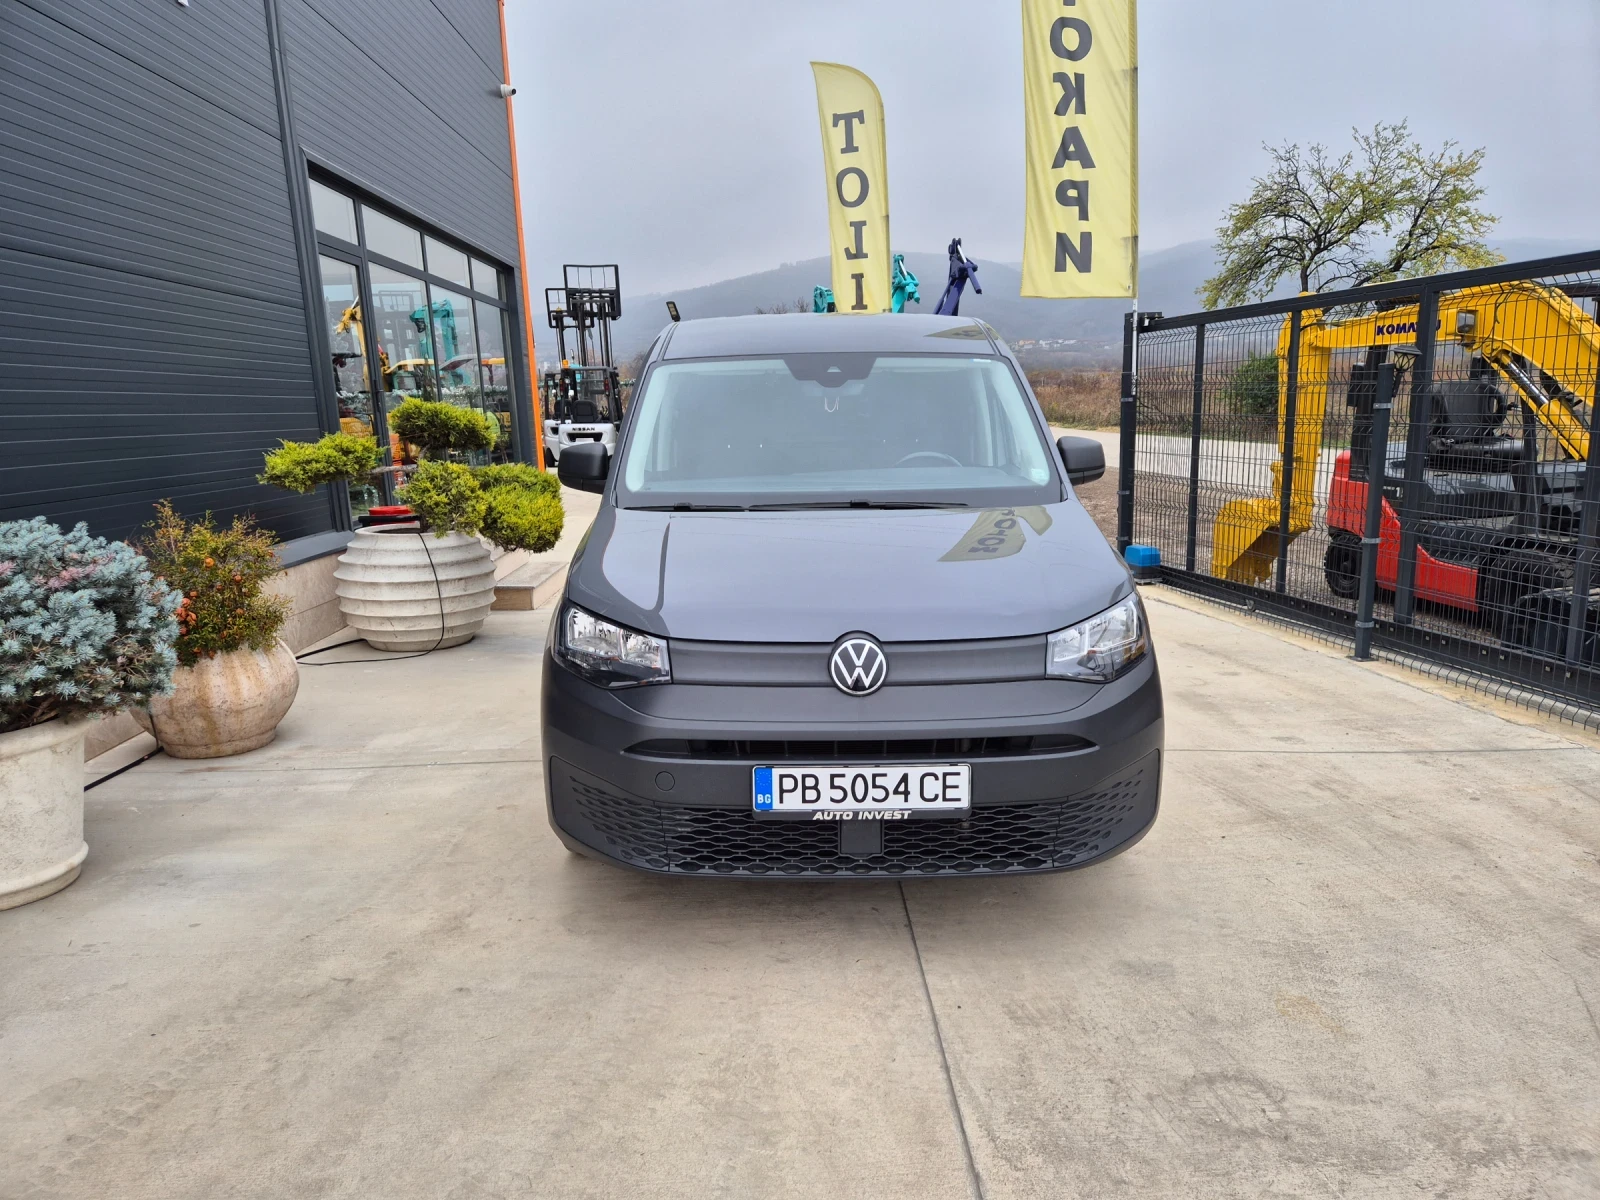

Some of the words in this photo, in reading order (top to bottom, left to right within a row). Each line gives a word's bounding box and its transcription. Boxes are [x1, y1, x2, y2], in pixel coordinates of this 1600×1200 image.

[1376, 320, 1442, 336] KOMA
[829, 772, 911, 804] 5054
[757, 793, 772, 804] BG
[812, 810, 853, 821] AUTO
[857, 810, 912, 820] INVEST
